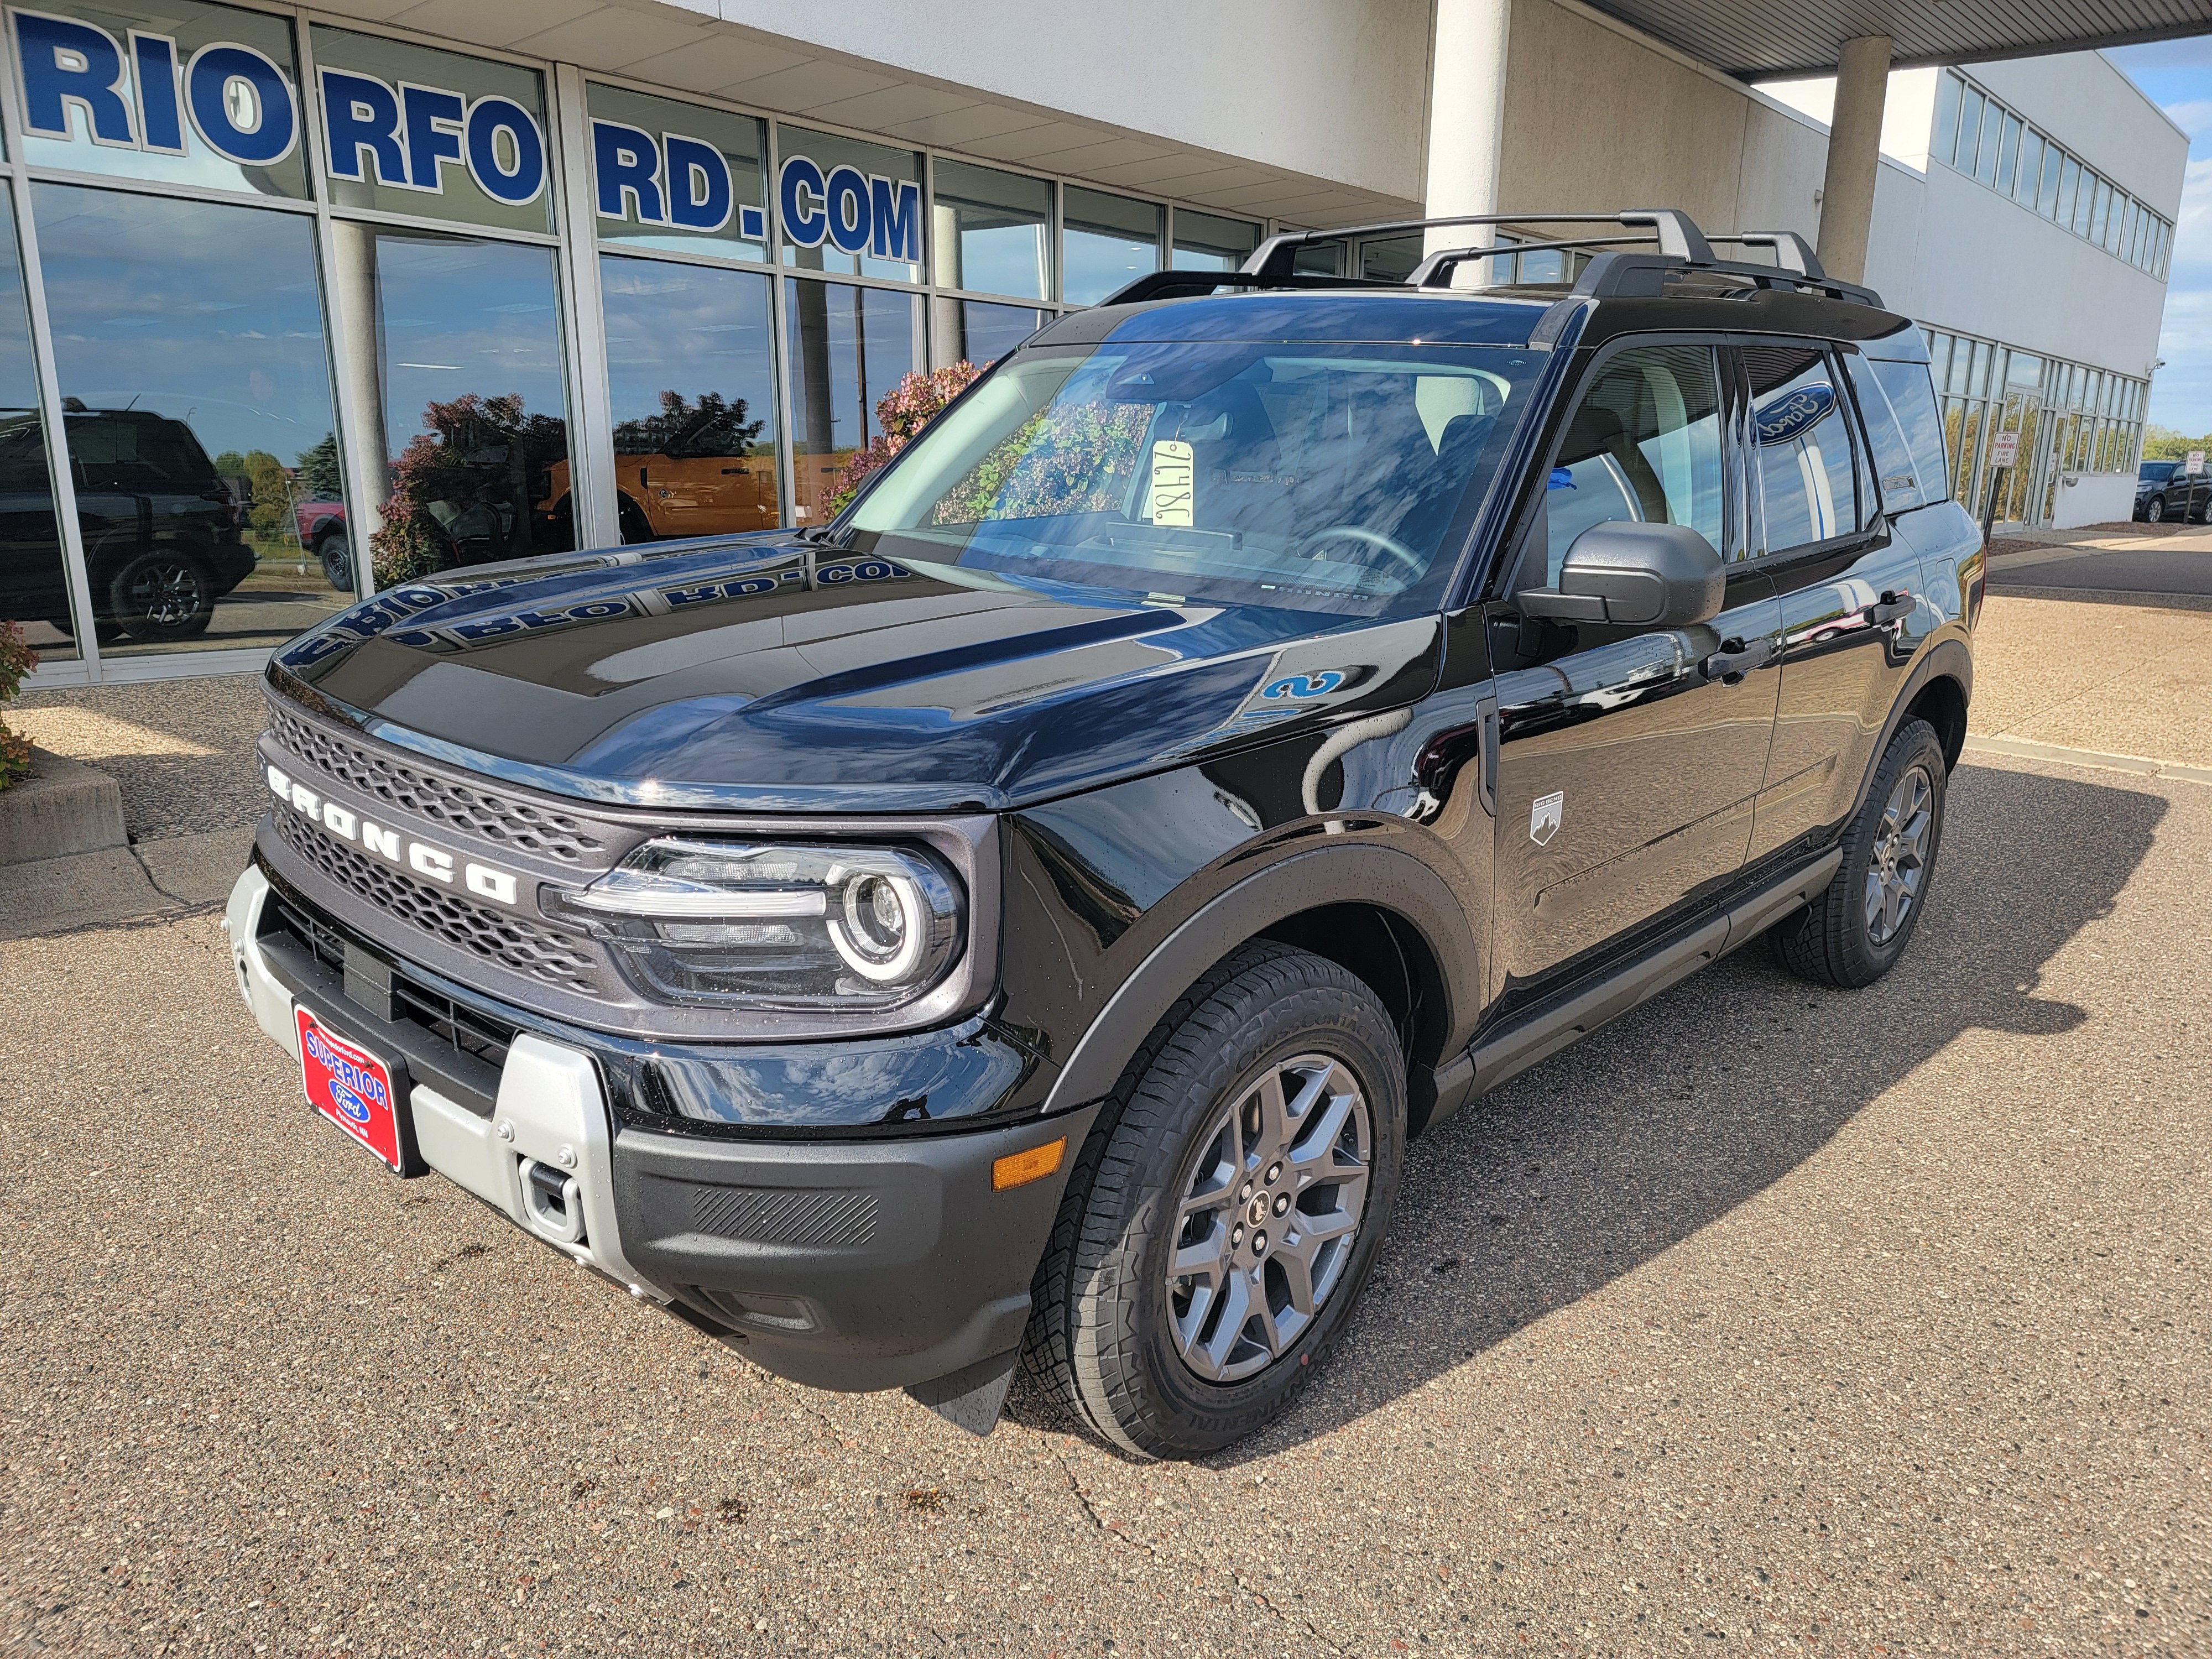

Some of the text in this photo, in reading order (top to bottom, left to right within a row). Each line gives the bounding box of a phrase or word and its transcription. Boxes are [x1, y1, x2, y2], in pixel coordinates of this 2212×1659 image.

[1546, 795, 1562, 804] BEND
[267, 764, 518, 905] BRONCO
[305, 1029, 389, 1111] SUPERIOR
[336, 1084, 361, 1118] Ford
